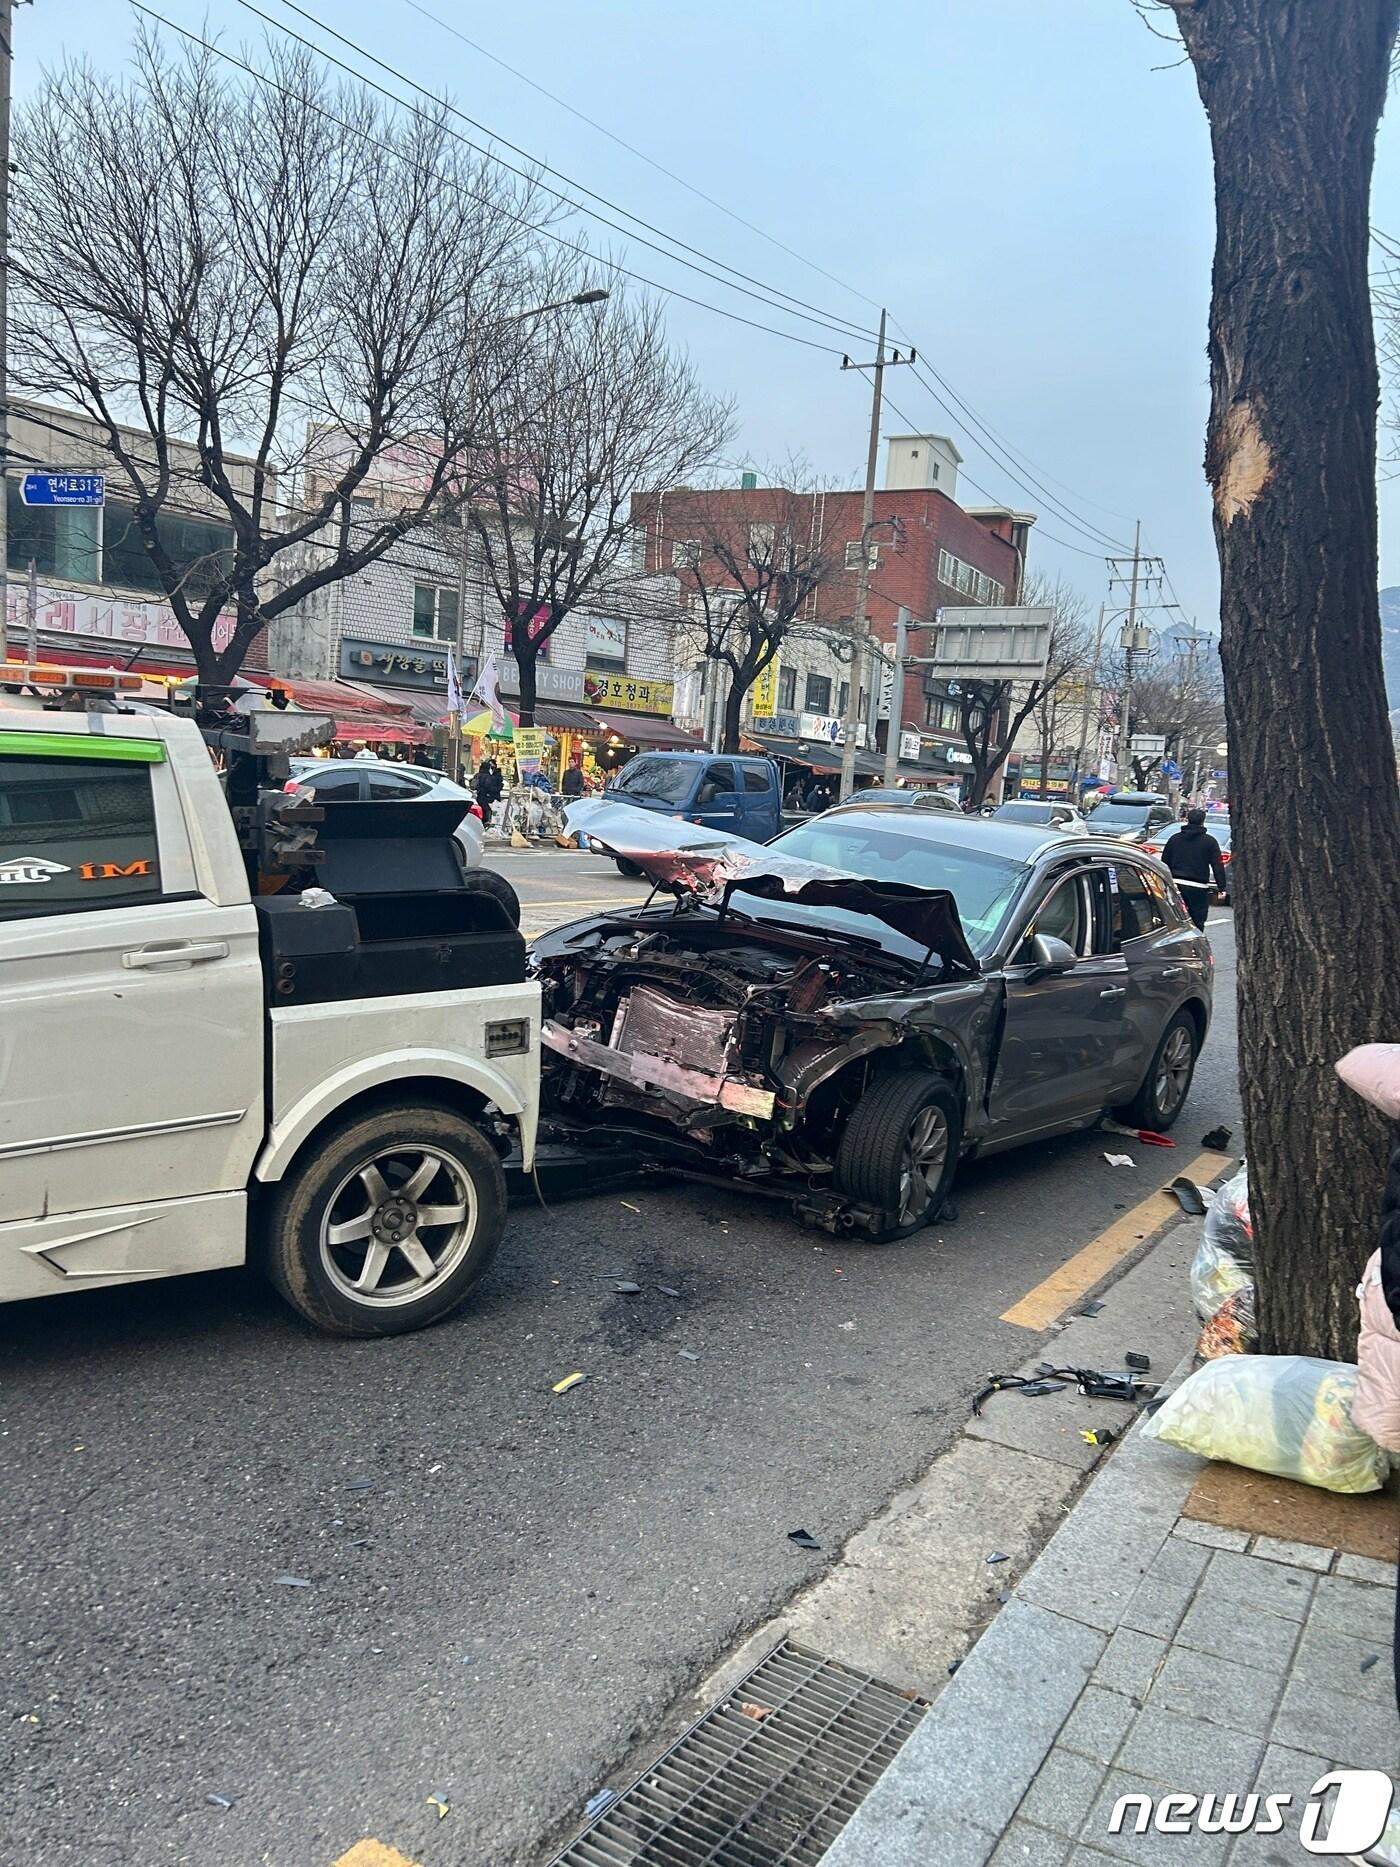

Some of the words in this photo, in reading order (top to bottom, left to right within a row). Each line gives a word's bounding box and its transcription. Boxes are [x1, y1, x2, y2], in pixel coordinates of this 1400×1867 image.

[48, 478, 103, 493] 연서로31길
[53, 494, 85, 503] Yeonseo-ro
[86, 496, 103, 504] 31-gil
[503, 667, 550, 688] BETY
[553, 674, 582, 691] SHOP
[599, 679, 650, 703] 경호청과
